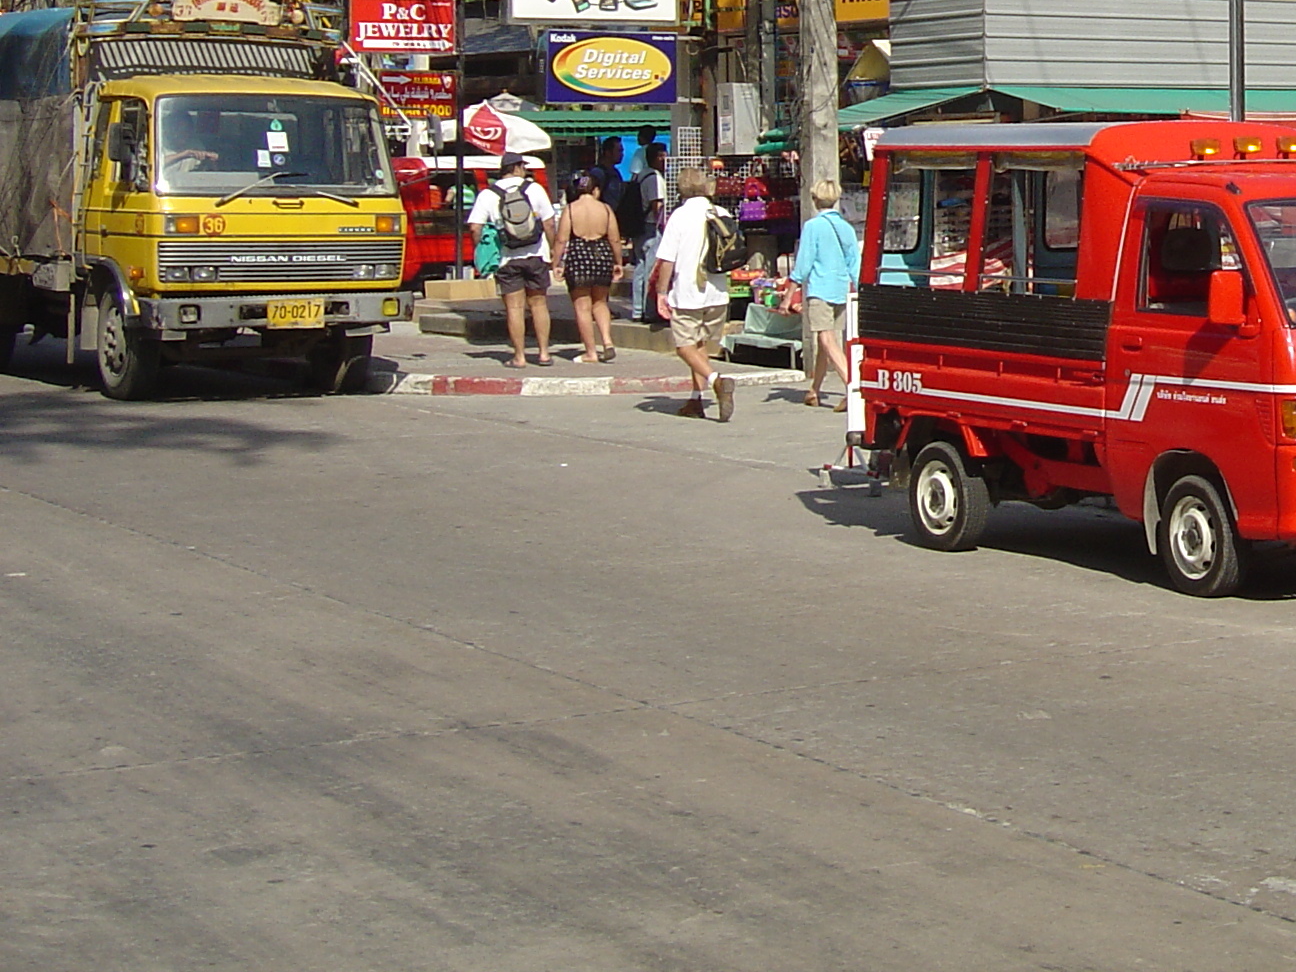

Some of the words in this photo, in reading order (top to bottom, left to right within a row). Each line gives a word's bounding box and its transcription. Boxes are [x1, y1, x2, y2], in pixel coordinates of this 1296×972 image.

[382, 2, 426, 21] P&C
[355, 21, 452, 42] JEWELRY
[550, 33, 577, 43] Kodak
[583, 48, 647, 67] Digital
[575, 64, 653, 80] Services
[423, 104, 453, 116] FOOD
[202, 216, 223, 233] 36
[230, 254, 289, 264] NISSAN
[291, 254, 348, 264] DIESEL
[271, 301, 322, 320] 70-0217
[877, 369, 890, 390] B
[893, 370, 923, 394] 305
